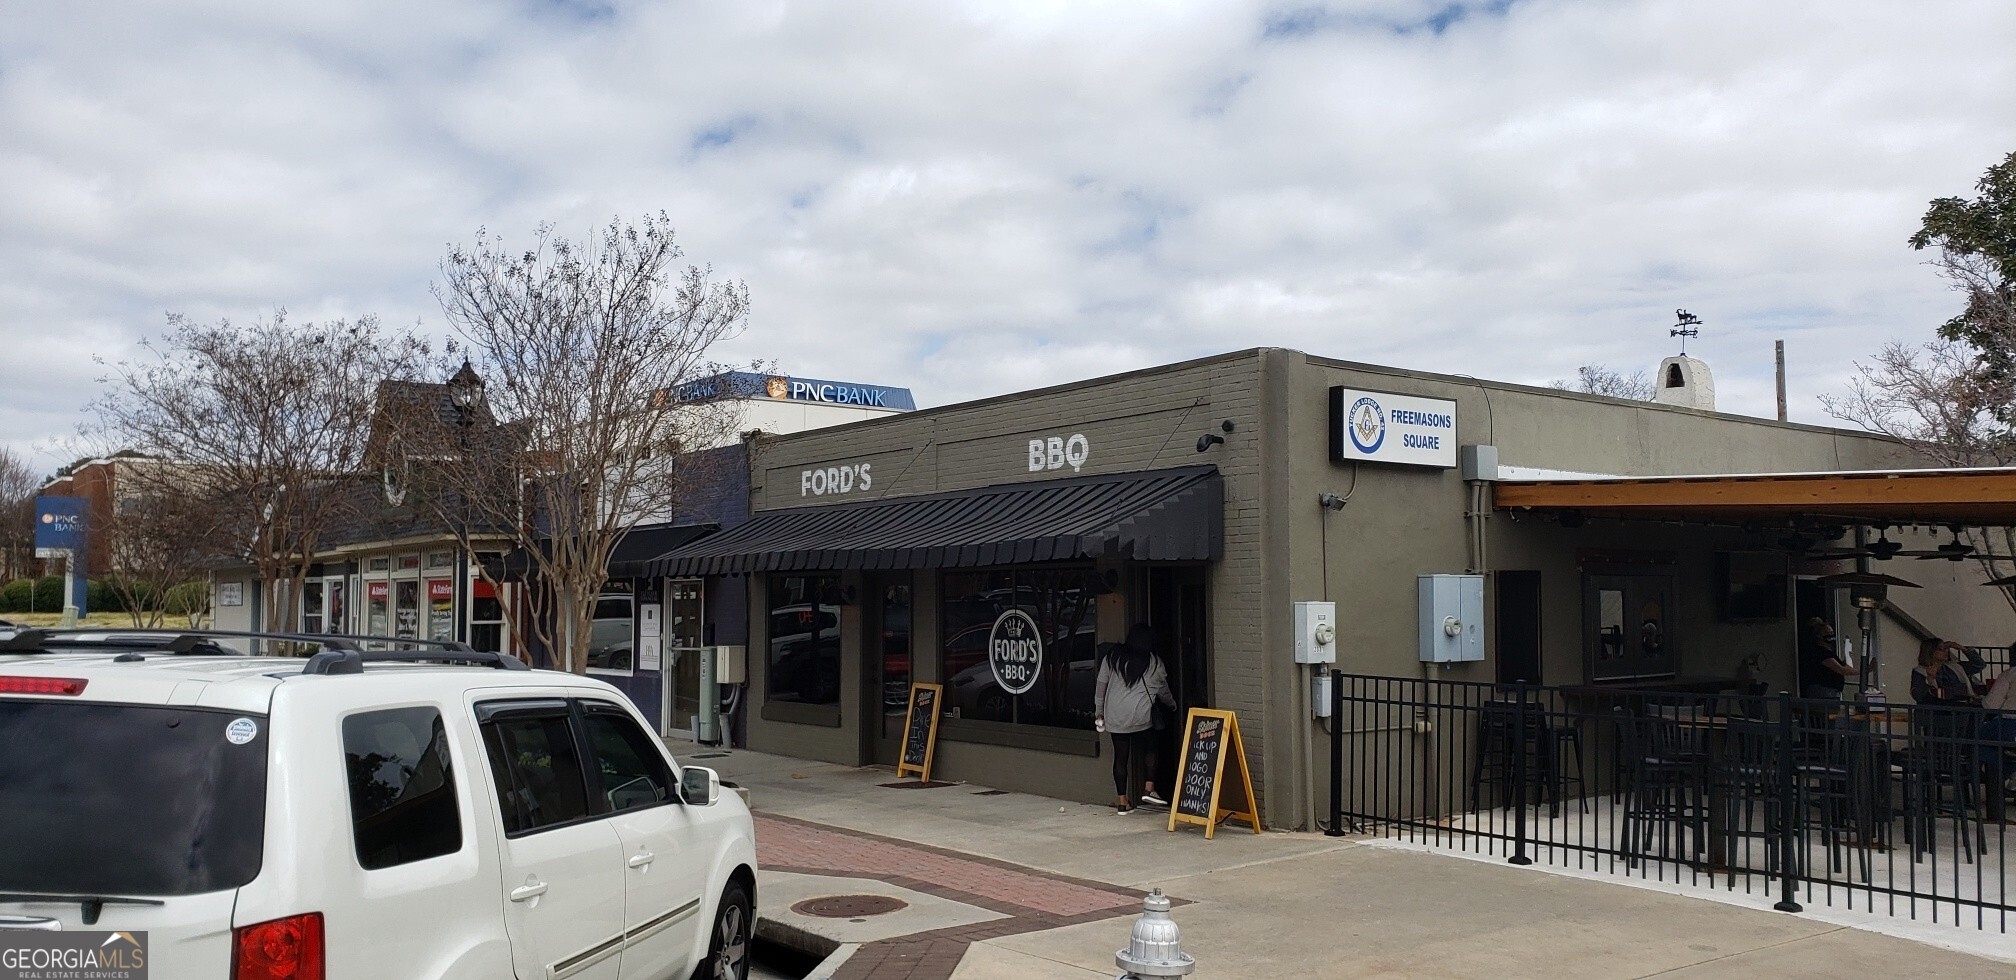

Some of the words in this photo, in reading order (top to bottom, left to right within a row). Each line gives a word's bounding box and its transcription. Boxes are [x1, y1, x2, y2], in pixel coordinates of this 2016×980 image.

[836, 385, 887, 407] BANK
[1391, 409, 1451, 429] FREEMASONS
[1403, 433, 1440, 450] SQUARE
[1028, 433, 1089, 472] BBQ
[801, 463, 872, 497] FORD'S
[54, 524, 85, 532] BANK
[55, 515, 78, 523] PNC
[994, 637, 1038, 663] FORD'S
[1005, 664, 1026, 681] BBQ
[1186, 785, 1207, 799] ONLY
